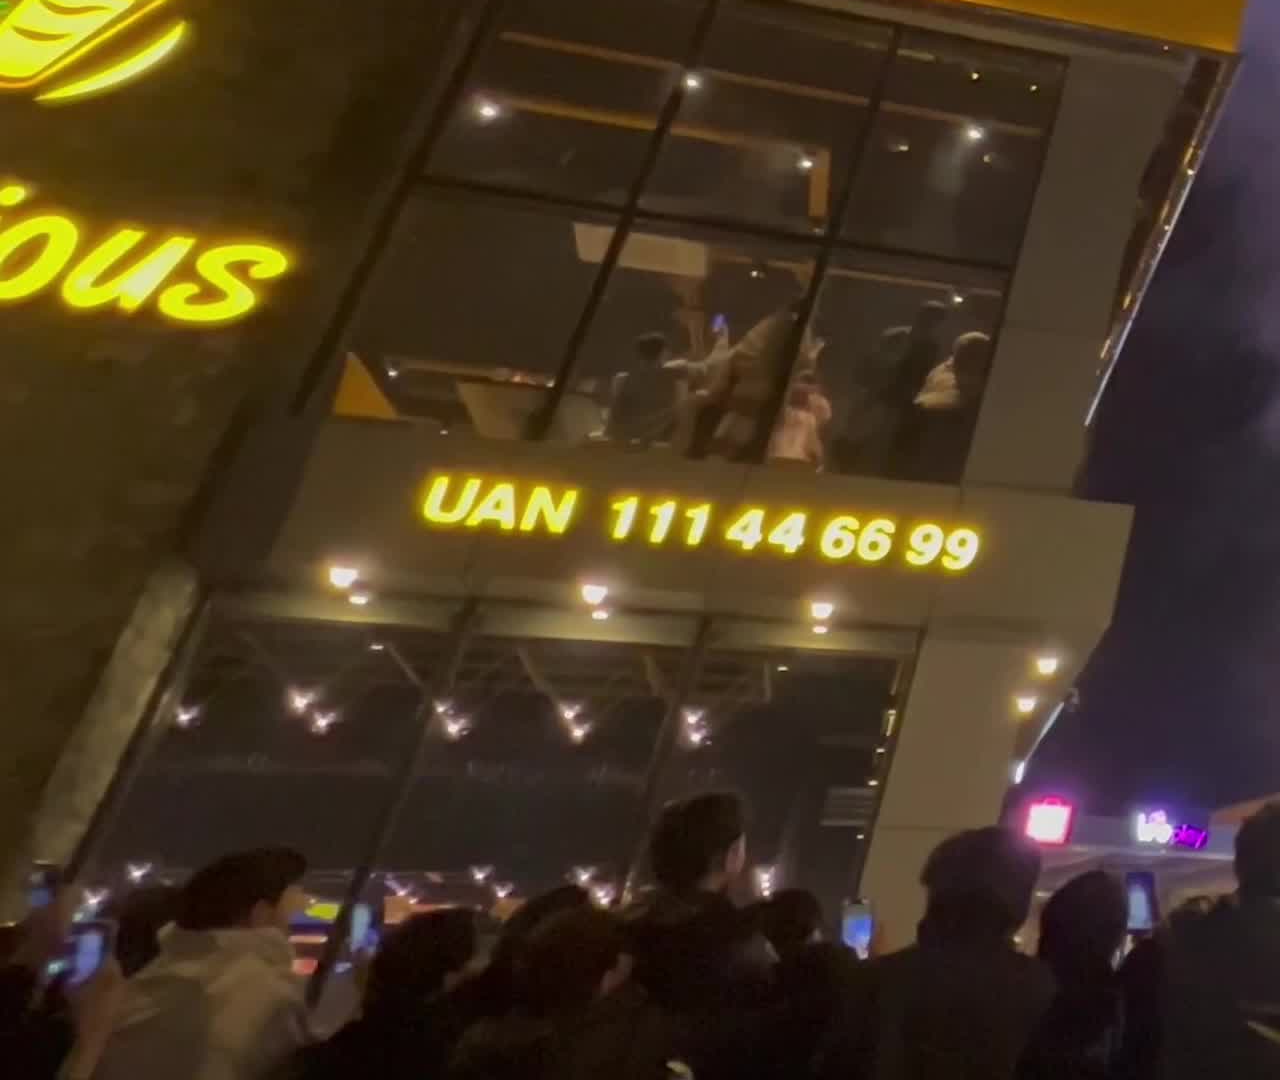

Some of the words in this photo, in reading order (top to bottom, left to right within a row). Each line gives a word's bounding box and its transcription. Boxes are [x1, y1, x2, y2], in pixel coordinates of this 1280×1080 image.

[420, 474, 579, 535] UAN
[609, 495, 713, 547] 111
[723, 505, 809, 555] 44
[815, 513, 897, 563] 66
[903, 520, 982, 572] 99
